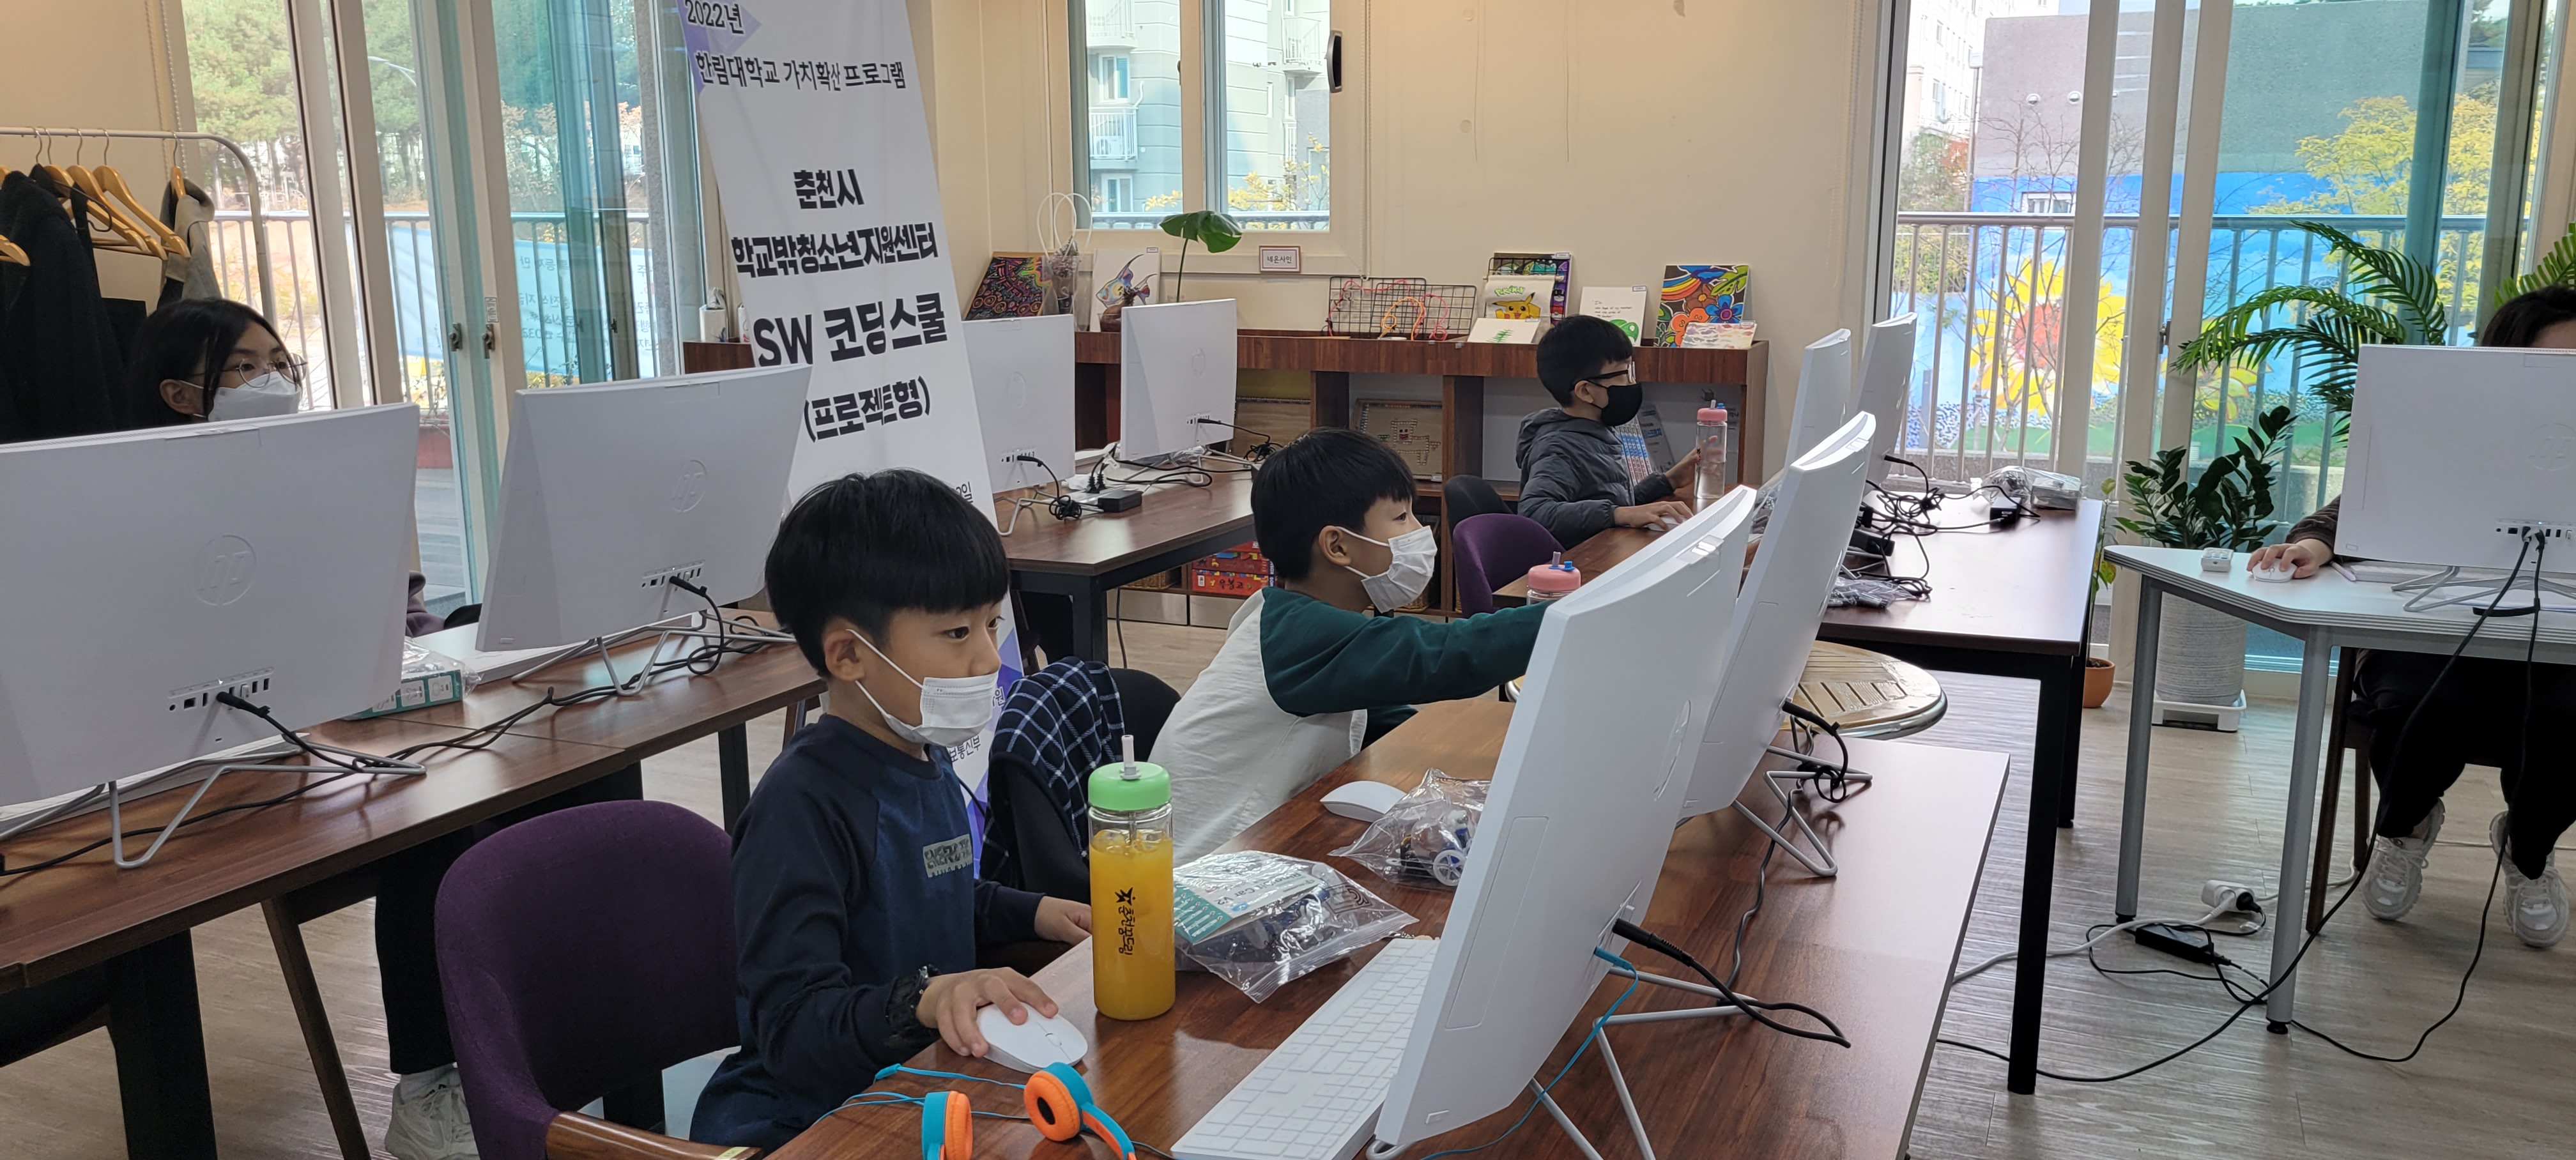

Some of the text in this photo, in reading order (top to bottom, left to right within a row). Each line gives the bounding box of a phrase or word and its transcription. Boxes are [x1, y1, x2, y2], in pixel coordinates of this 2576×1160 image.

[684, 1, 744, 34] 2022년
[696, 52, 907, 91] 한림대학교 가치확산 프로그램
[793, 169, 864, 210] 춘천시
[731, 222, 939, 278] 학교밖청소년지원센터
[1267, 255, 1292, 264] 네온사인
[753, 293, 947, 367] SW 코딩스쿨
[804, 376, 930, 443] (프로젝트형)
[949, 735, 981, 763] 보통신부
[1118, 904, 1135, 956] 춘천꿈드림
